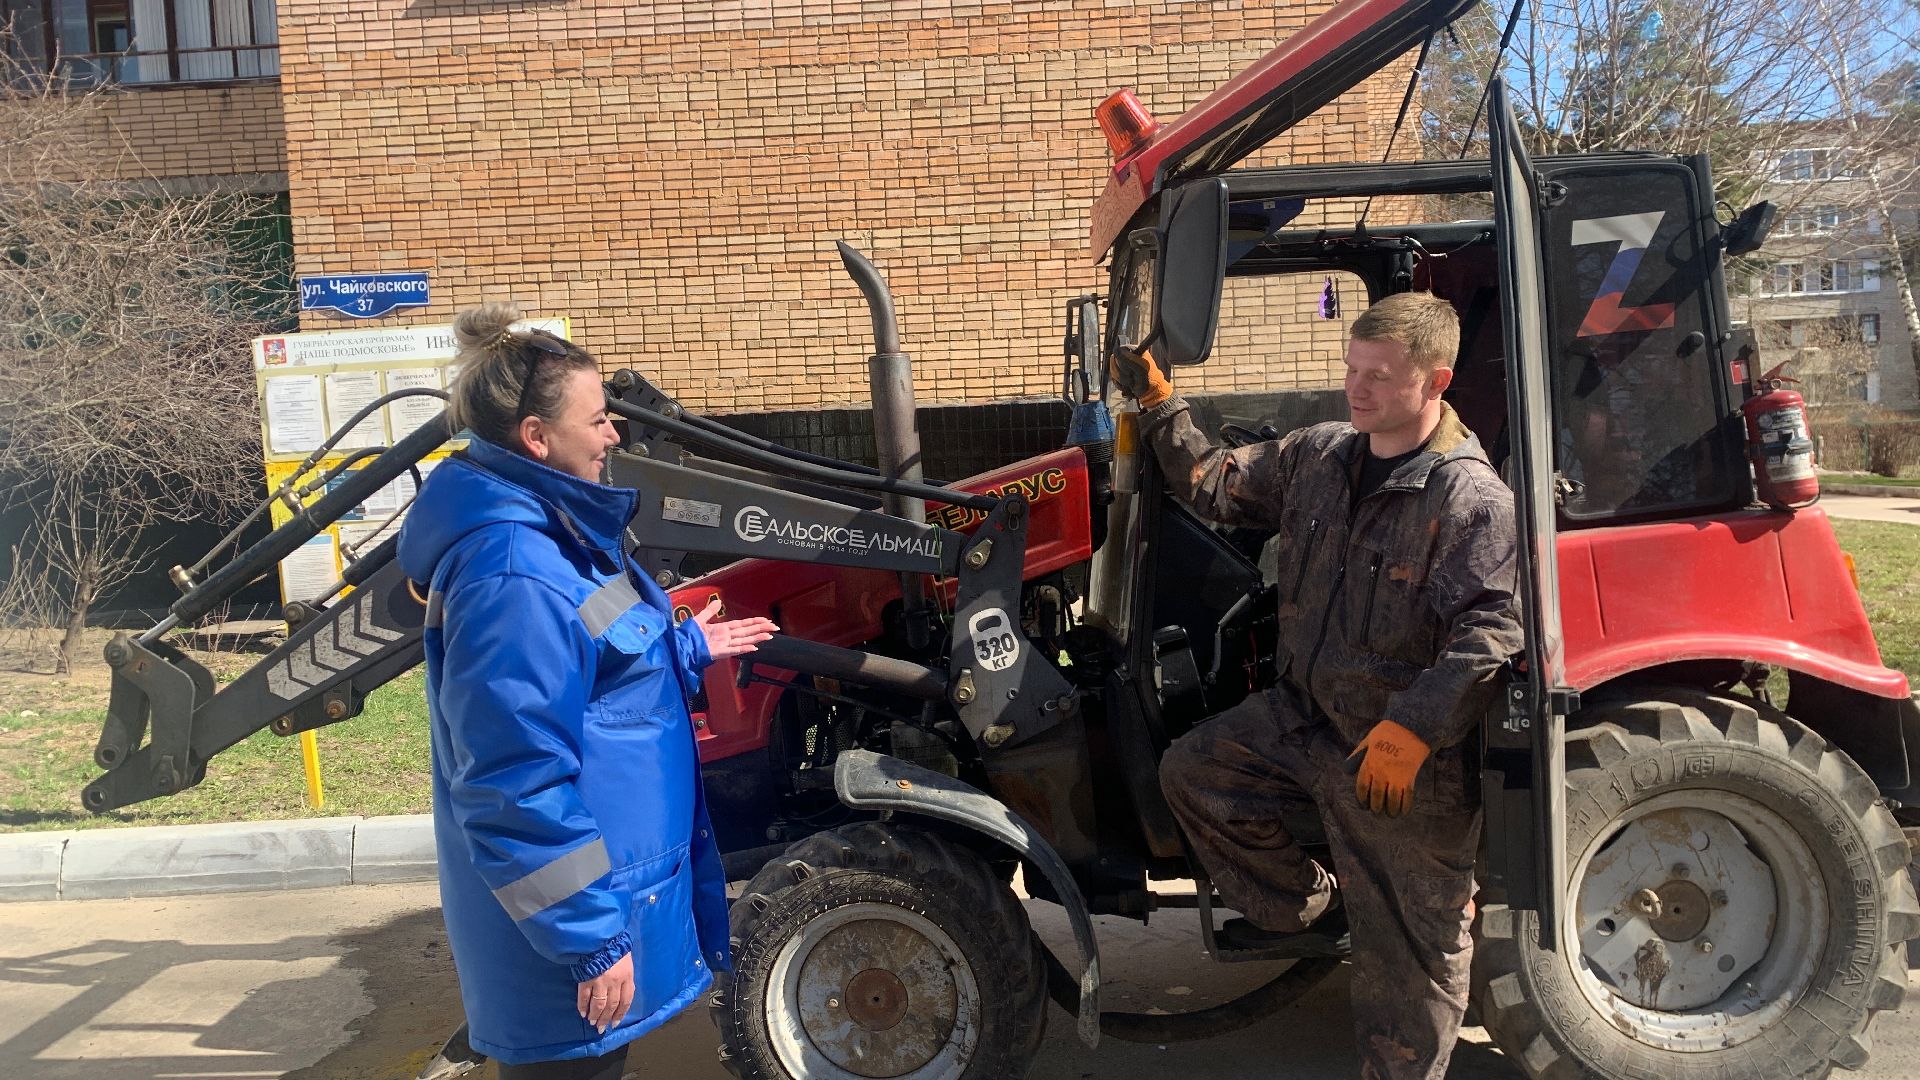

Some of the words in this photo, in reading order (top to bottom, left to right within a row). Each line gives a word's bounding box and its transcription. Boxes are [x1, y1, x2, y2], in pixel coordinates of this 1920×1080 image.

[1571, 210, 1675, 338] Z
[303, 283, 326, 298] ул.
[330, 279, 428, 294] Чайковского
[357, 298, 374, 312] 37
[333, 344, 416, 357] ПОДМОСКОВЬЕ»
[777, 538, 816, 549] ОСНОВАН
[848, 547, 869, 556] ГОДУ
[976, 632, 1016, 661] 320
[1825, 814, 1876, 987] BELSHINA
